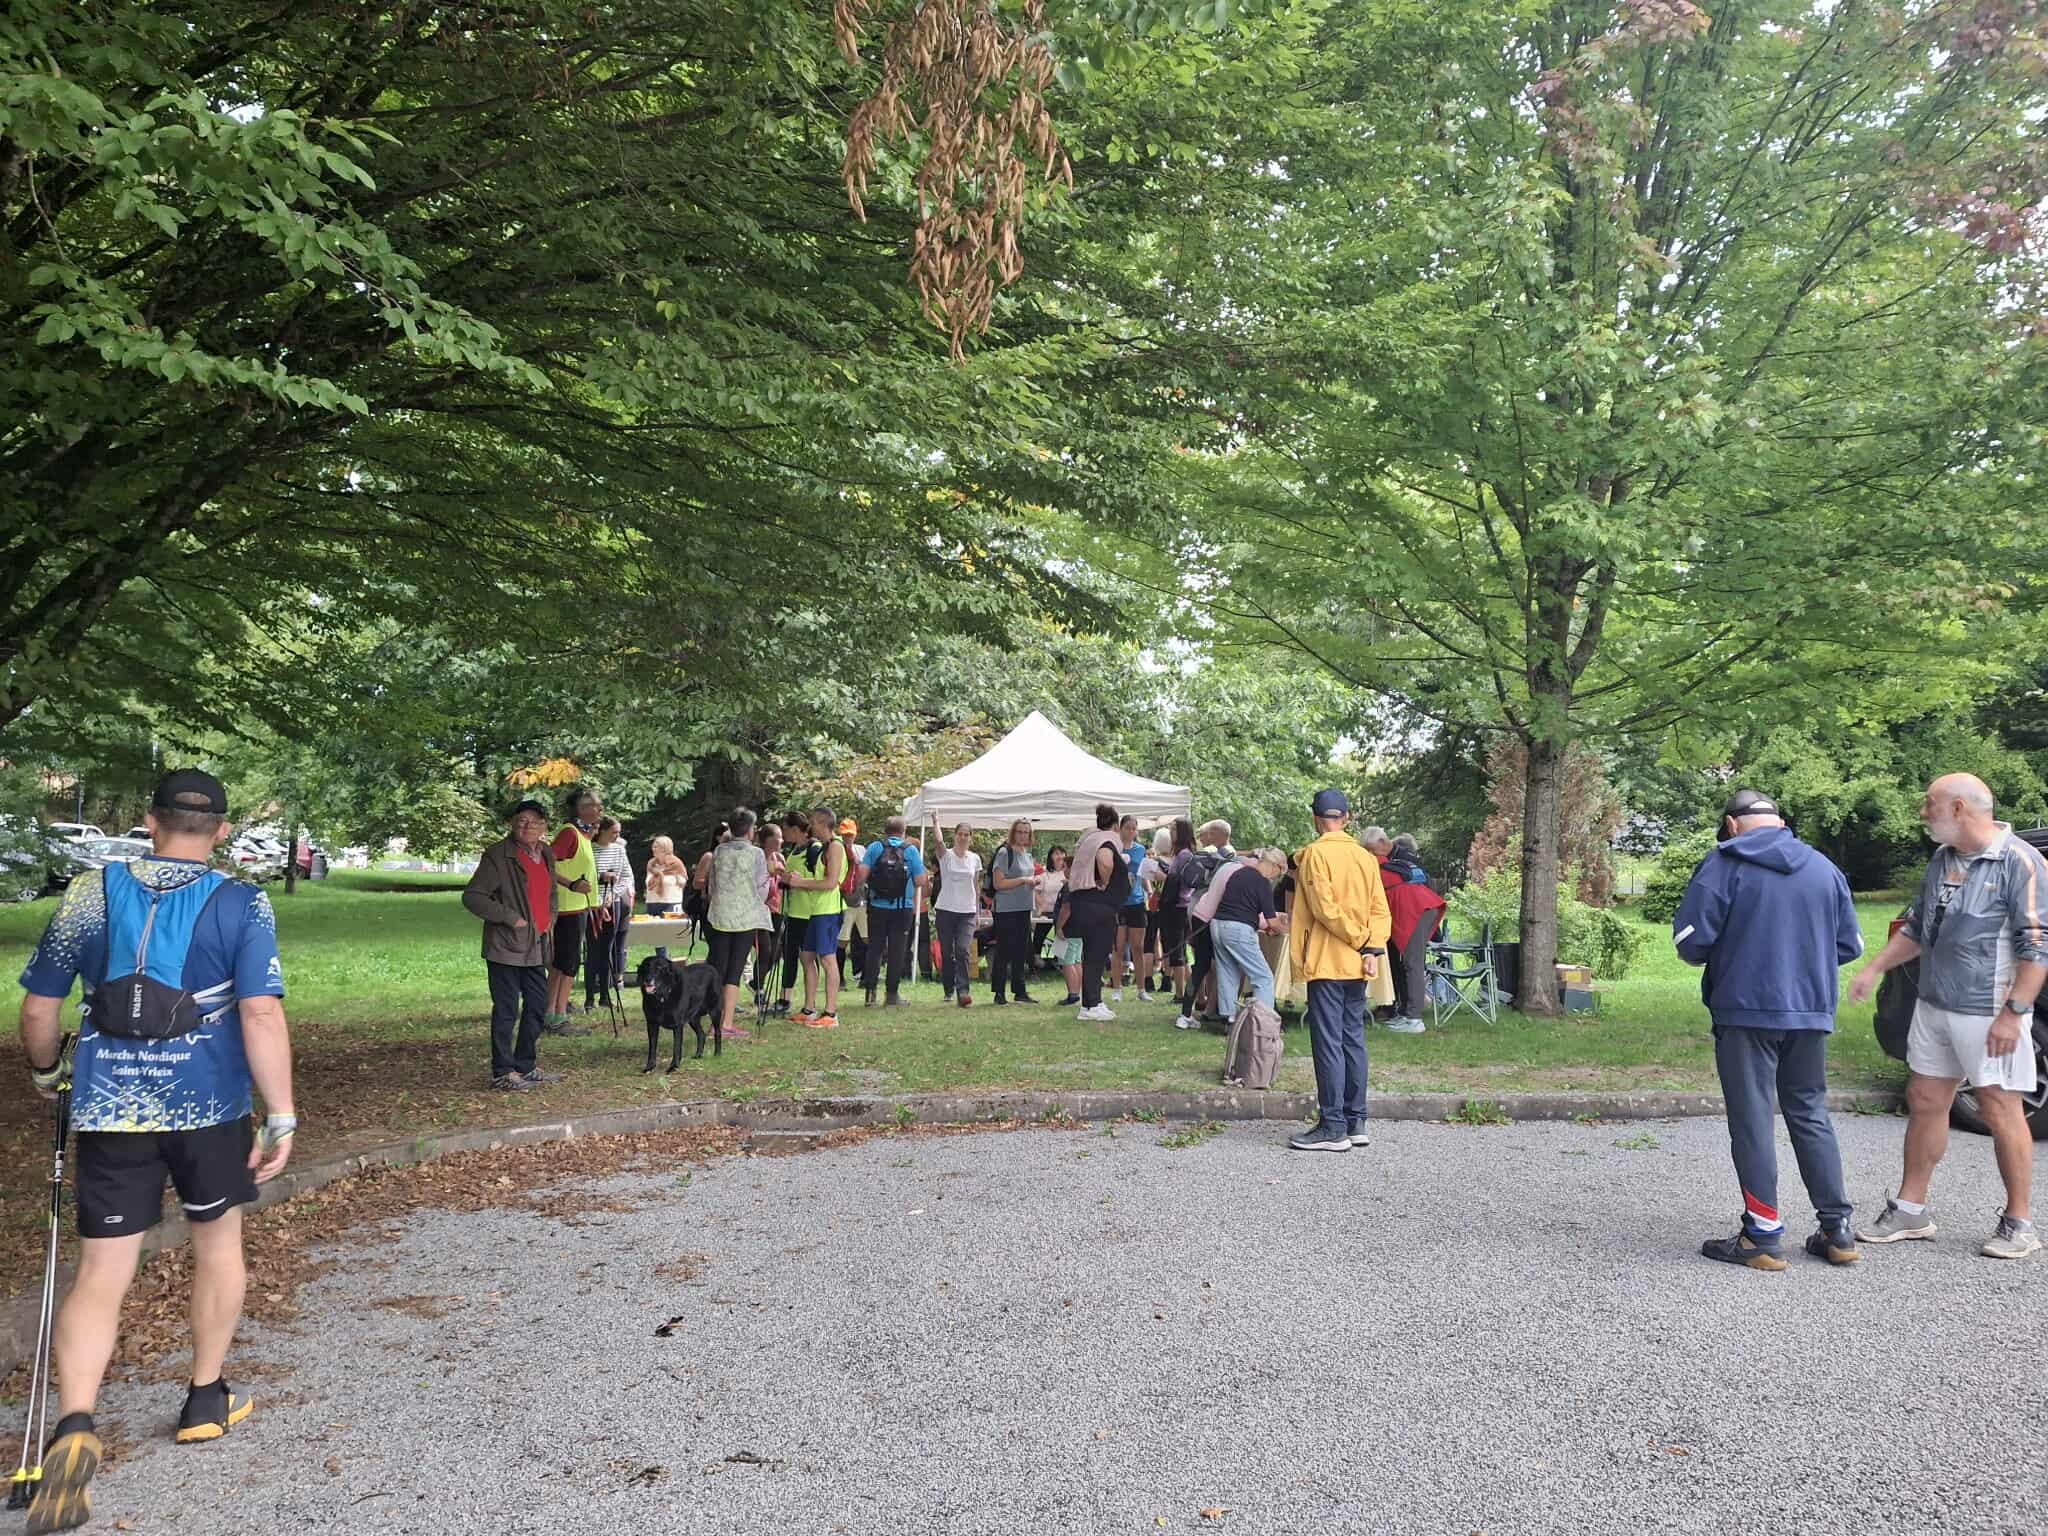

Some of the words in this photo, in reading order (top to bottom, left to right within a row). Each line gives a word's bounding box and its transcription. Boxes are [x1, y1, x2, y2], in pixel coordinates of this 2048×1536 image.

[132, 983, 143, 1018] EVADICT
[96, 1048, 136, 1060] Marche
[138, 1050, 191, 1064] Nordique
